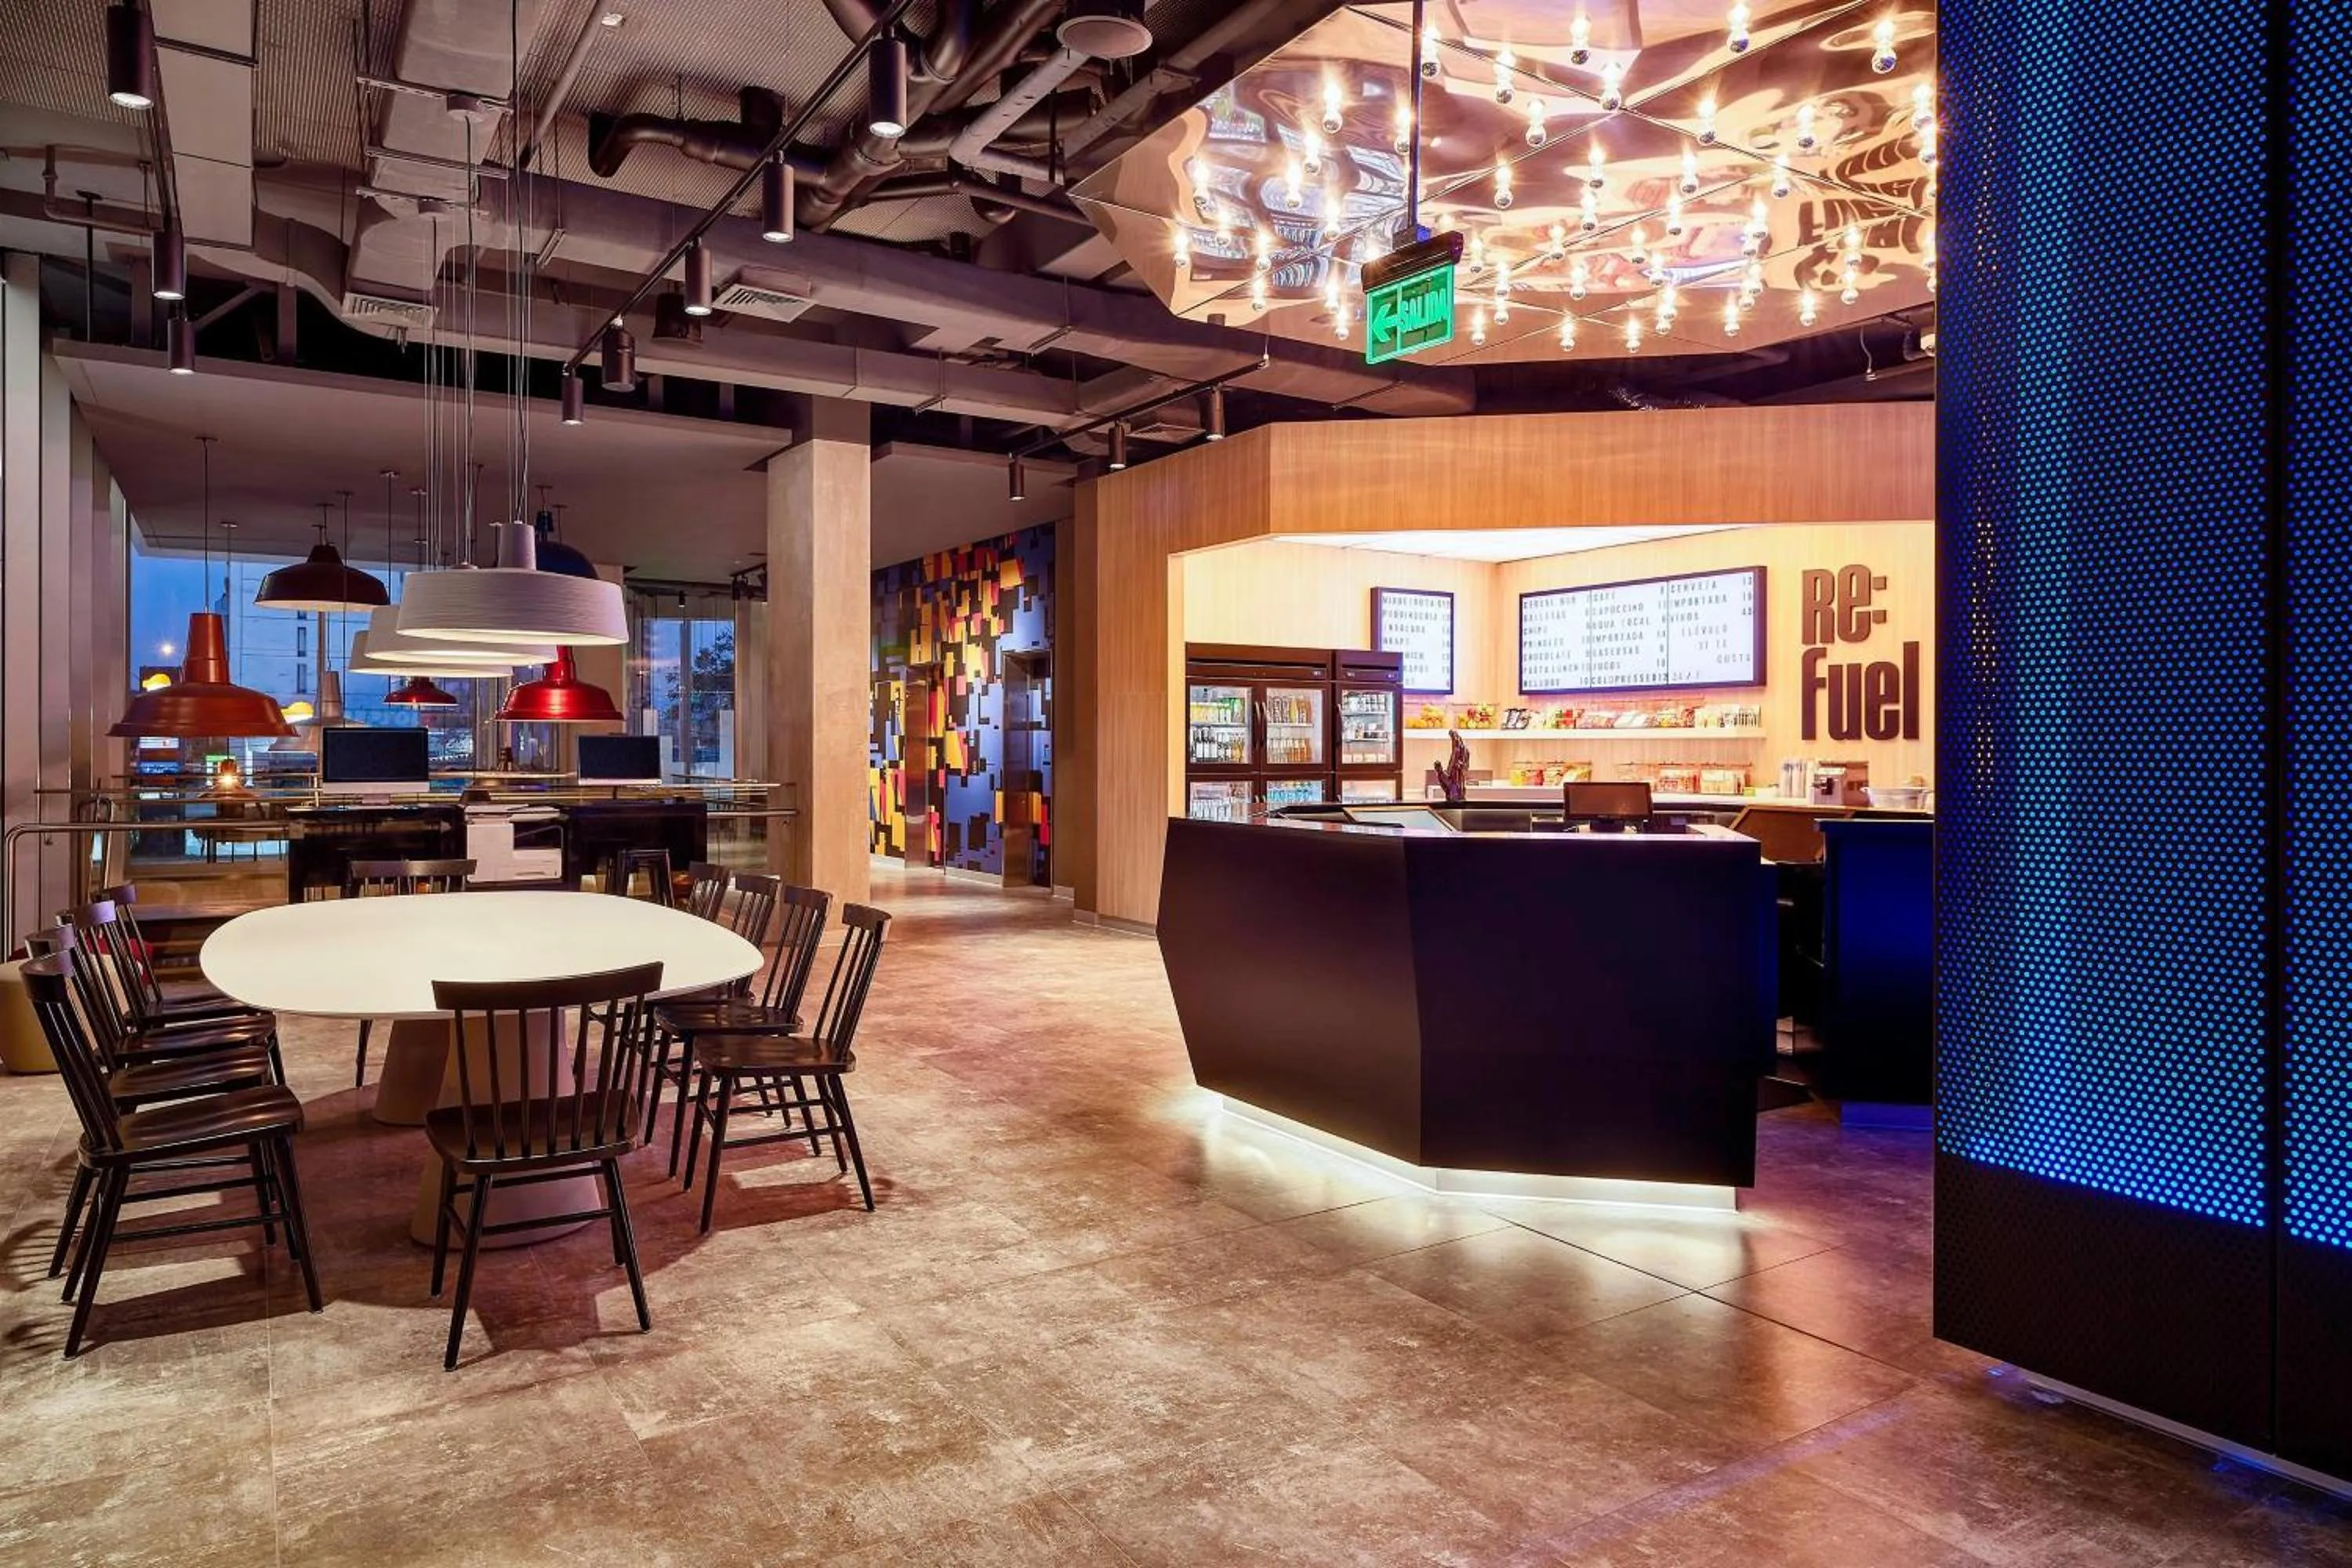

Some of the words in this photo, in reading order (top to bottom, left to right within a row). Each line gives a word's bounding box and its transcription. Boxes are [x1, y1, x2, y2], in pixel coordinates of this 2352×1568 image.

[1399, 289, 1448, 333] SALIDA
[1669, 594, 1726, 607] IMPORTADA
[1802, 564, 1887, 644] Re:
[1592, 631, 1642, 643] IMPORTADA
